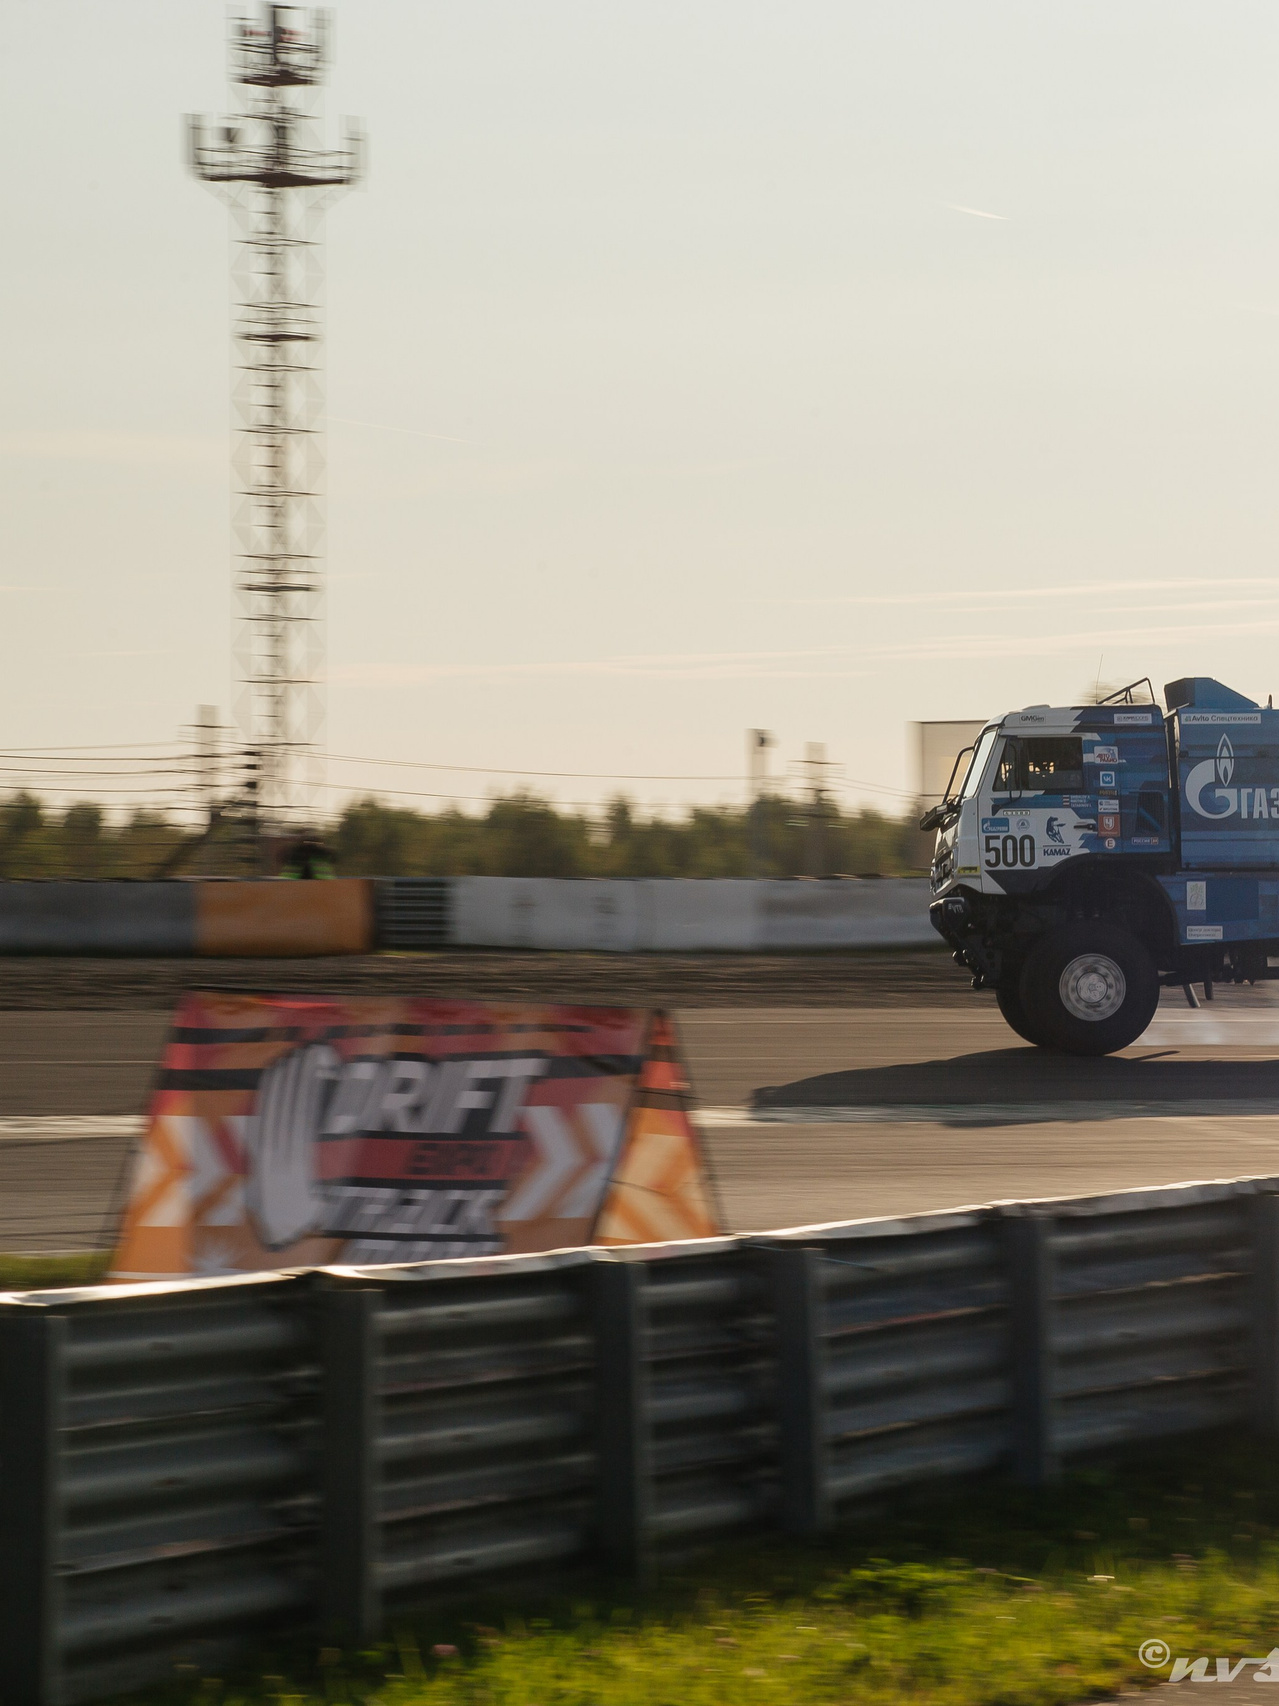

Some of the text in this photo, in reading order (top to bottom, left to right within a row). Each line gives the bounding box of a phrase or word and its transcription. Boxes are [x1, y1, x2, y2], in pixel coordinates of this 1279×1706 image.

[1192, 714, 1259, 723] Avito Спецтехника
[984, 834, 1036, 868] 500
[1043, 848, 1071, 856] KAMAZ
[320, 1056, 549, 1134] DRIFT
